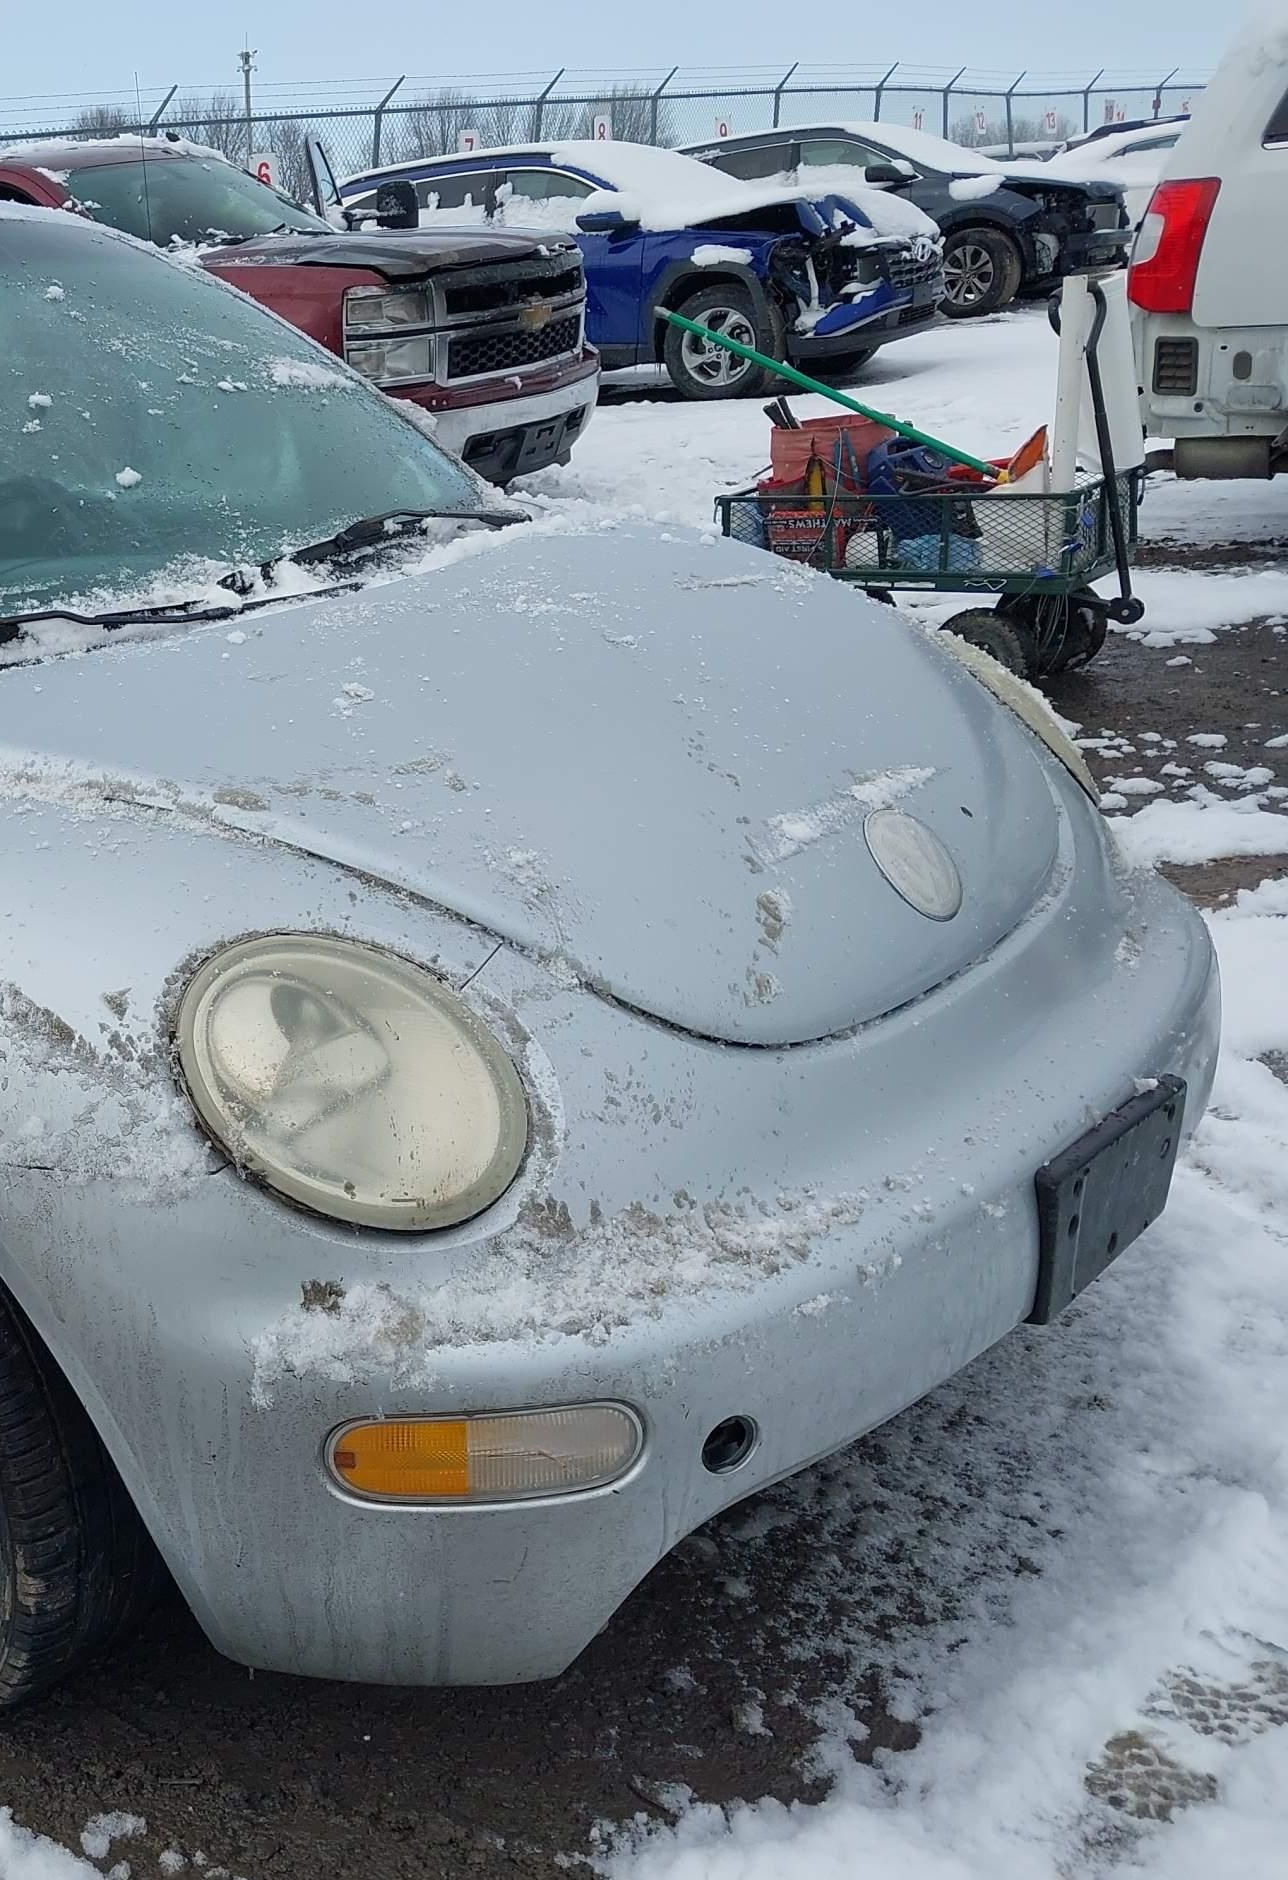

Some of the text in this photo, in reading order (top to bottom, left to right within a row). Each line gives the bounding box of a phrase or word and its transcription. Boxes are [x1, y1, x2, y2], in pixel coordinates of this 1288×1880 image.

[1046, 111, 1055, 129] 13
[464, 138, 474, 151] 7
[257, 161, 271, 184] 6
